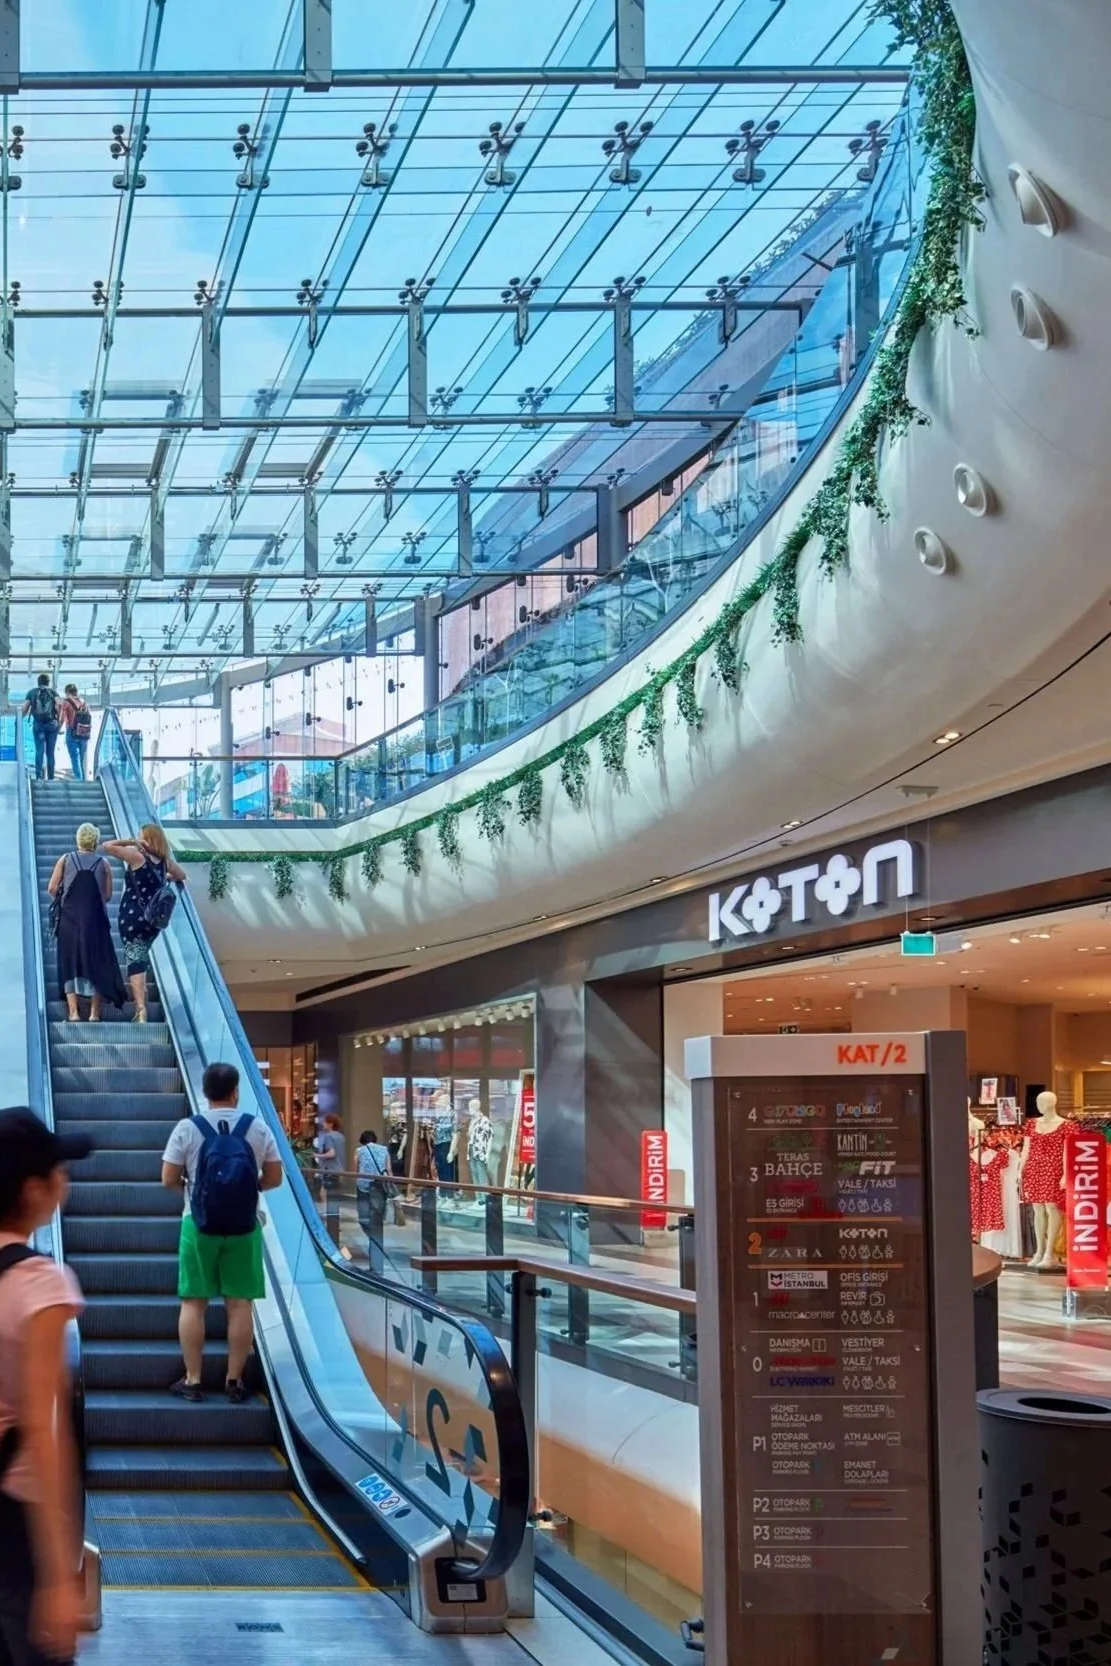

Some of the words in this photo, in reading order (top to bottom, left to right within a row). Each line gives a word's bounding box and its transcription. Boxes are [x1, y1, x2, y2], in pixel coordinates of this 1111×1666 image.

[837, 1042, 907, 1067] KAT/2
[748, 1107, 758, 1123] 4
[777, 1152, 809, 1161] TERAS
[750, 1167, 759, 1182] 3
[765, 1163, 823, 1178] BAHÇE
[838, 1179, 861, 1189] VALE
[748, 1232, 762, 1254] 2
[767, 1248, 823, 1258] ZARA
[784, 1272, 814, 1280] METRO
[753, 1292, 758, 1306] 1
[769, 1338, 810, 1348] DANIŞMA
[842, 1357, 865, 1367] VALE
[771, 1433, 809, 1441] OTOPARK
[844, 1432, 863, 1441] ATM
[753, 1436, 766, 1451] P1
[772, 1461, 810, 1469] OTOPARK
[844, 1461, 876, 1469] EMANET
[753, 1497, 770, 1512] P2
[773, 1499, 811, 1507] OTOPARK
[753, 1525, 770, 1540] P3
[773, 1527, 812, 1535] OTOPARK
[754, 1553, 771, 1568] P4
[774, 1555, 812, 1563] OTOPARK
